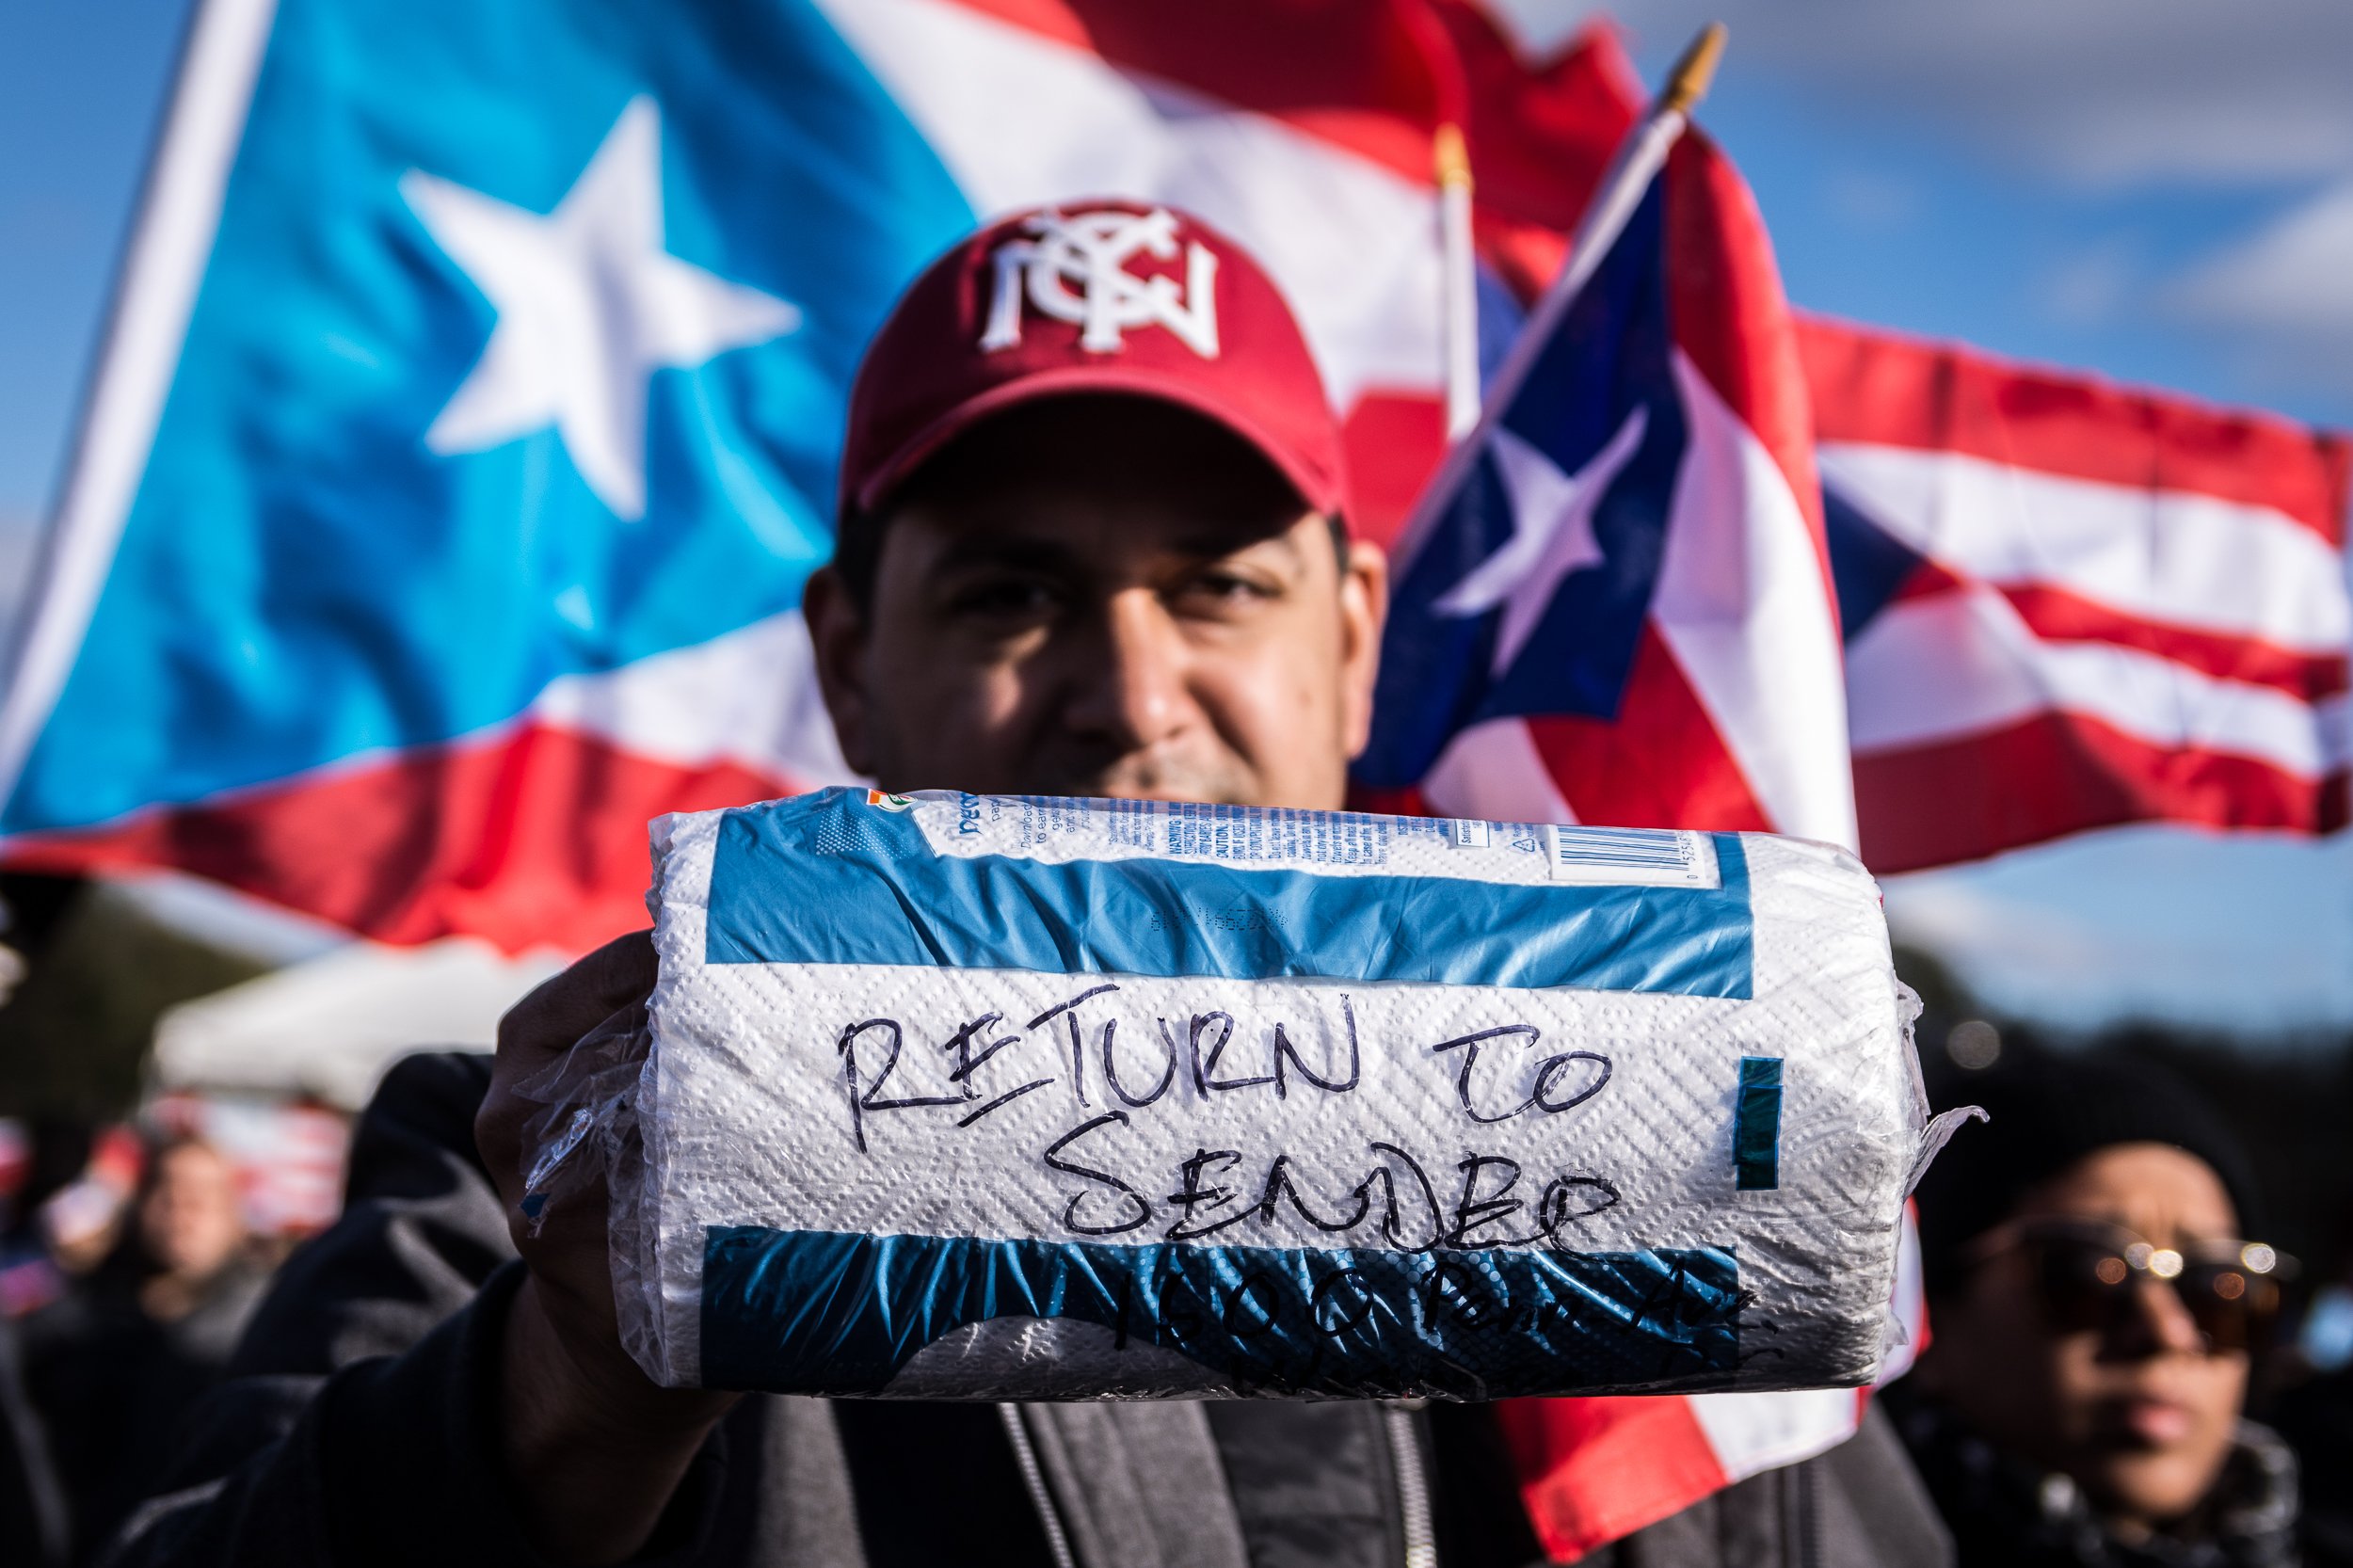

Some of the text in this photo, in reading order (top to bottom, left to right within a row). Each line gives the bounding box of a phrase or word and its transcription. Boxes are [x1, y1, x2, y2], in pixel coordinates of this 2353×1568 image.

[1035, 832, 1047, 843] to
[838, 984, 1361, 1152] RETURN
[1044, 1111, 1628, 1263] SENDER
